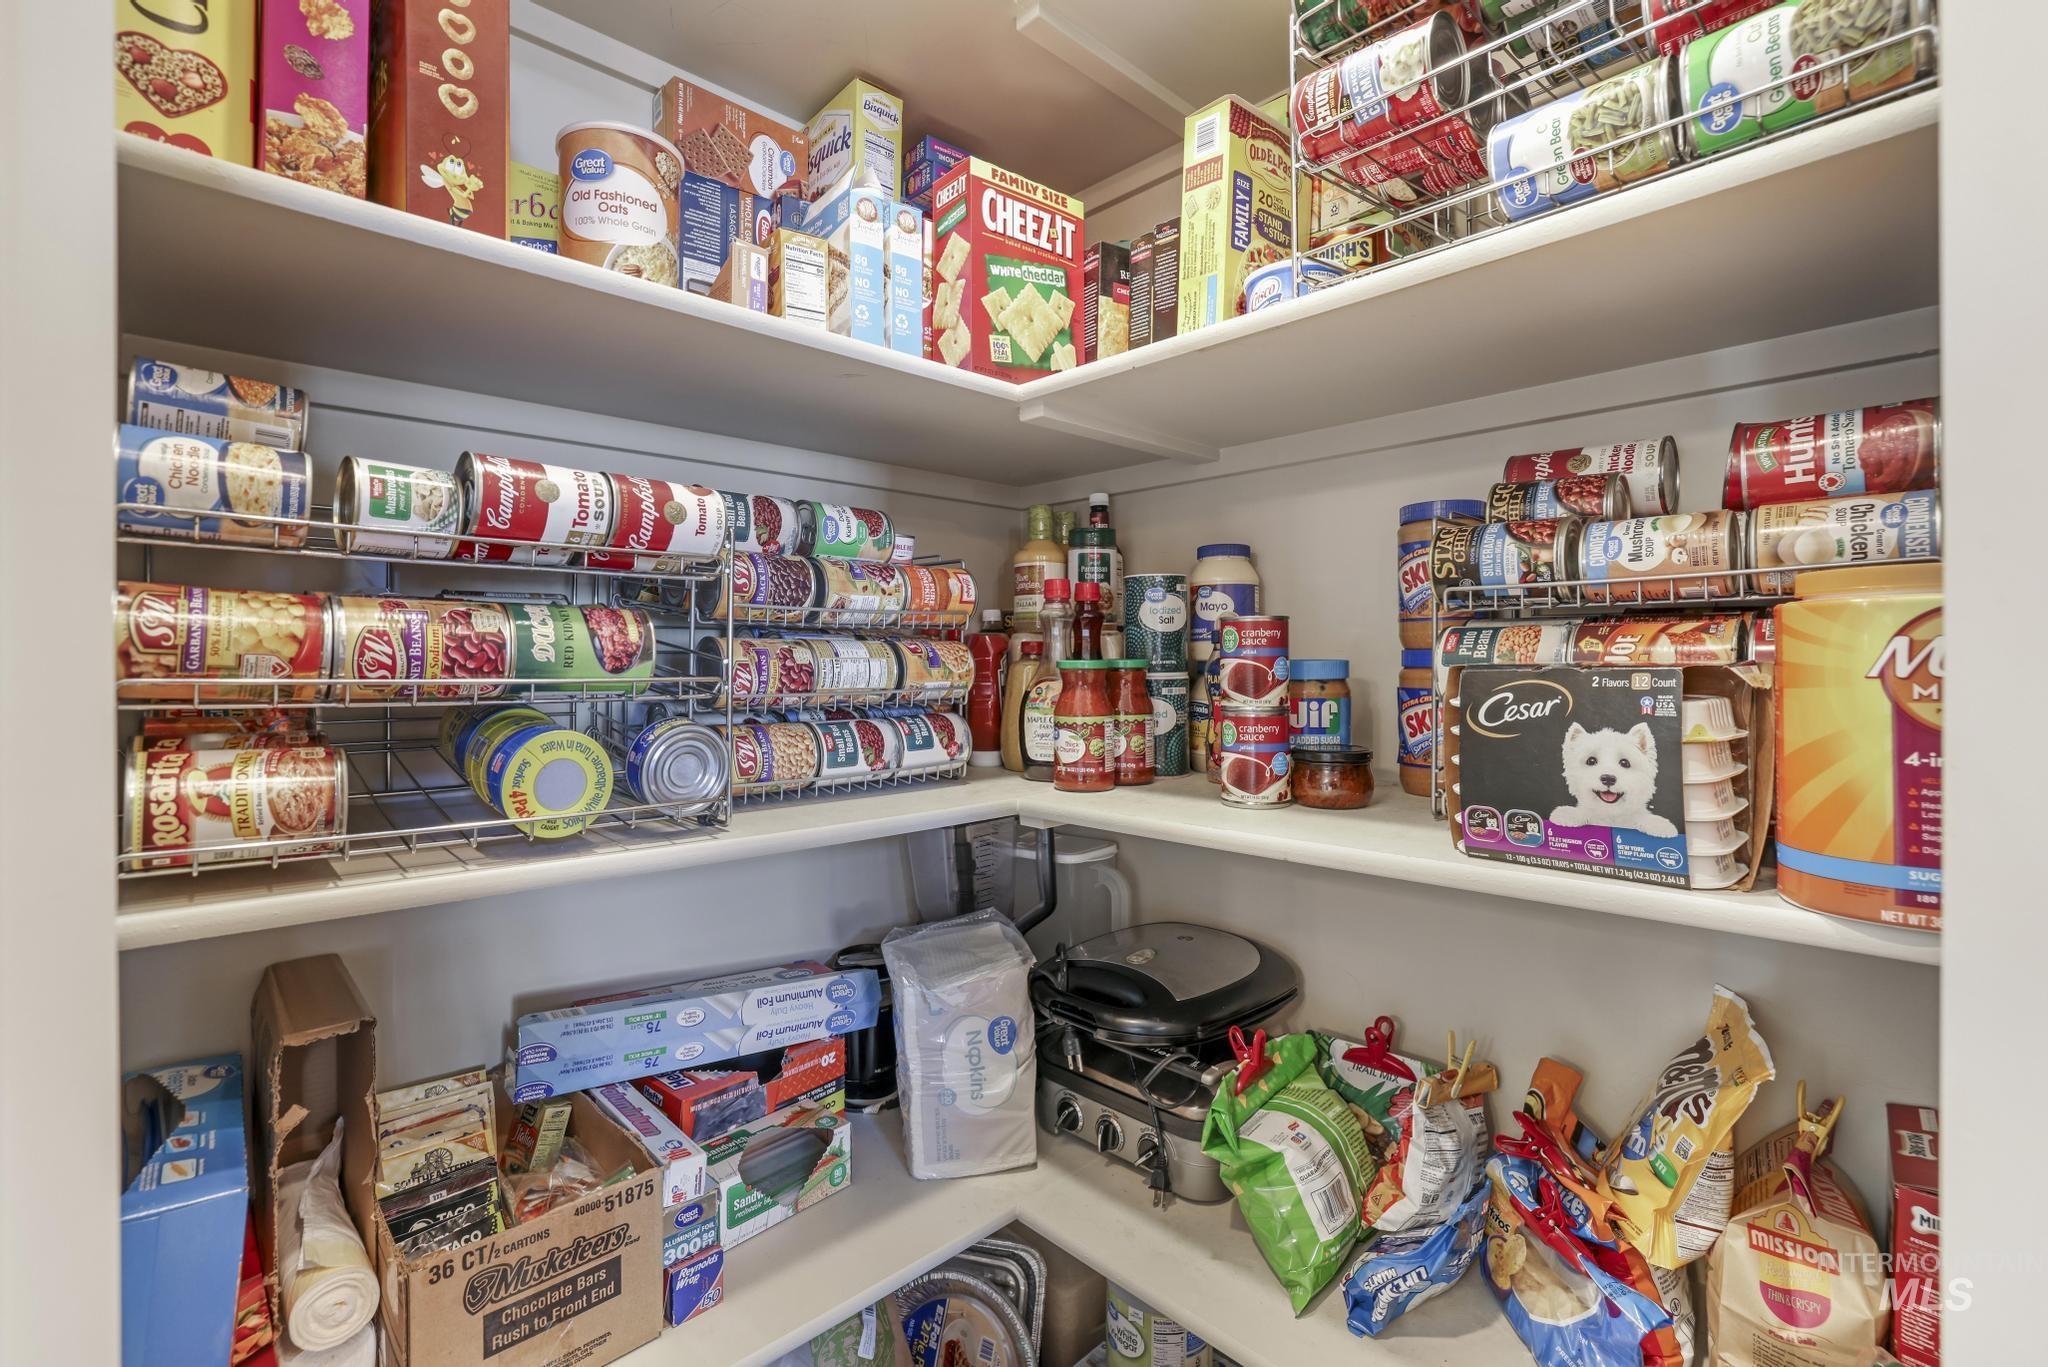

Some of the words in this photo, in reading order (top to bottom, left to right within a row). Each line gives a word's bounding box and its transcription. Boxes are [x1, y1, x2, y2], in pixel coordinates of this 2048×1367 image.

[1767, 13, 1781, 57] Beans
[575, 157, 605, 168] Great
[1250, 142, 1266, 162] OLD
[991, 168, 1040, 197] FAMILY
[1042, 188, 1069, 209] SIZE
[1236, 178, 1250, 190] SIZE
[572, 190, 590, 202] Old
[595, 189, 657, 213] Fashioned
[598, 202, 628, 215] Oats
[1258, 190, 1273, 208] 20
[575, 216, 596, 226] 100%
[599, 215, 629, 228] Whole
[632, 221, 656, 237] Grain
[1234, 190, 1250, 248] FAMILY
[1258, 212, 1283, 230] STAND
[855, 277, 870, 288] NO
[1022, 265, 1065, 286] cheddar
[895, 287, 909, 298] NO
[1624, 443, 1637, 475] Noodle
[1832, 452, 1840, 465] No
[572, 471, 589, 529] Tomato
[593, 478, 605, 522] SOUP
[695, 498, 707, 536] Tomato
[737, 501, 745, 528] Beans
[1850, 504, 1875, 561] Chicken
[1877, 529, 1885, 547] Cream
[1646, 537, 1654, 557] SOUP
[756, 579, 766, 601] BLACK
[1149, 606, 1181, 615] Iodized
[1200, 602, 1228, 613] Mayo
[561, 607, 574, 643] KIDNEY
[1159, 615, 1175, 624] Salt
[408, 616, 421, 657] BEANS
[1241, 628, 1281, 640] cranberry
[1241, 637, 1267, 645] sauce
[1459, 631, 1477, 656] Pinto
[1473, 629, 1493, 658] Beans
[209, 641, 220, 656] 50%
[431, 626, 441, 665] Sodium
[563, 646, 574, 668] RED
[759, 654, 767, 678] BEANS
[1592, 676, 1599, 687] 2
[1602, 678, 1629, 687] Flavors
[1634, 677, 1648, 687] 12
[1652, 678, 1676, 687] Count
[1290, 700, 1338, 729] Jif
[1478, 691, 1561, 728] Cesar
[920, 718, 928, 738] Beans
[1239, 724, 1280, 735] cranberry
[1239, 733, 1264, 741] sauce
[576, 740, 595, 761] Tuna
[759, 730, 767, 757] BEANS
[838, 739, 846, 762] Small
[846, 729, 855, 753] Beans
[1297, 736, 1319, 746] ADDED
[1320, 736, 1341, 746] SUGAR
[592, 755, 606, 793] Albacore
[760, 757, 768, 779] WHITE
[146, 751, 190, 847] Rosarita
[236, 752, 252, 830] TRADITIONAL
[1548, 828, 1552, 836] 6
[1551, 861, 1569, 869] TRAYS
[1574, 863, 1592, 871] TOTAL
[1615, 868, 1624, 876] 1.2
[1625, 870, 1632, 879] kg
[1677, 877, 1685, 885] LB
[1881, 910, 1905, 924] NET
[1908, 912, 1929, 927] WT
[757, 994, 773, 1009] Foil
[776, 988, 823, 1005] Aluminum
[646, 1021, 661, 1033] 75
[756, 1028, 773, 1041] Foil
[775, 1020, 824, 1037] Aluminum
[965, 1029, 984, 1102] Napkins
[1351, 1063, 1379, 1080] TRAIL
[678, 1207, 699, 1224] Great
[664, 1228, 700, 1249] ALUMINUM
[701, 1222, 715, 1234] FOIL
[702, 1238, 715, 1248] FT
[428, 1260, 455, 1285] 36
[503, 1228, 550, 1254] CARTONS
[664, 1237, 701, 1265] 300
[494, 1223, 630, 1302] Musketeers
[678, 1252, 720, 1279] Reynolds
[676, 1274, 700, 1290] Wrap
[502, 1279, 572, 1325] Chocolate
[577, 1267, 608, 1290] Bars
[700, 1287, 720, 1308] 150
[1791, 1295, 1821, 1314] CRISPY
[492, 1324, 530, 1350] Rush
[534, 1318, 548, 1331] to
[552, 1294, 589, 1322] Front
[592, 1280, 615, 1304] End
